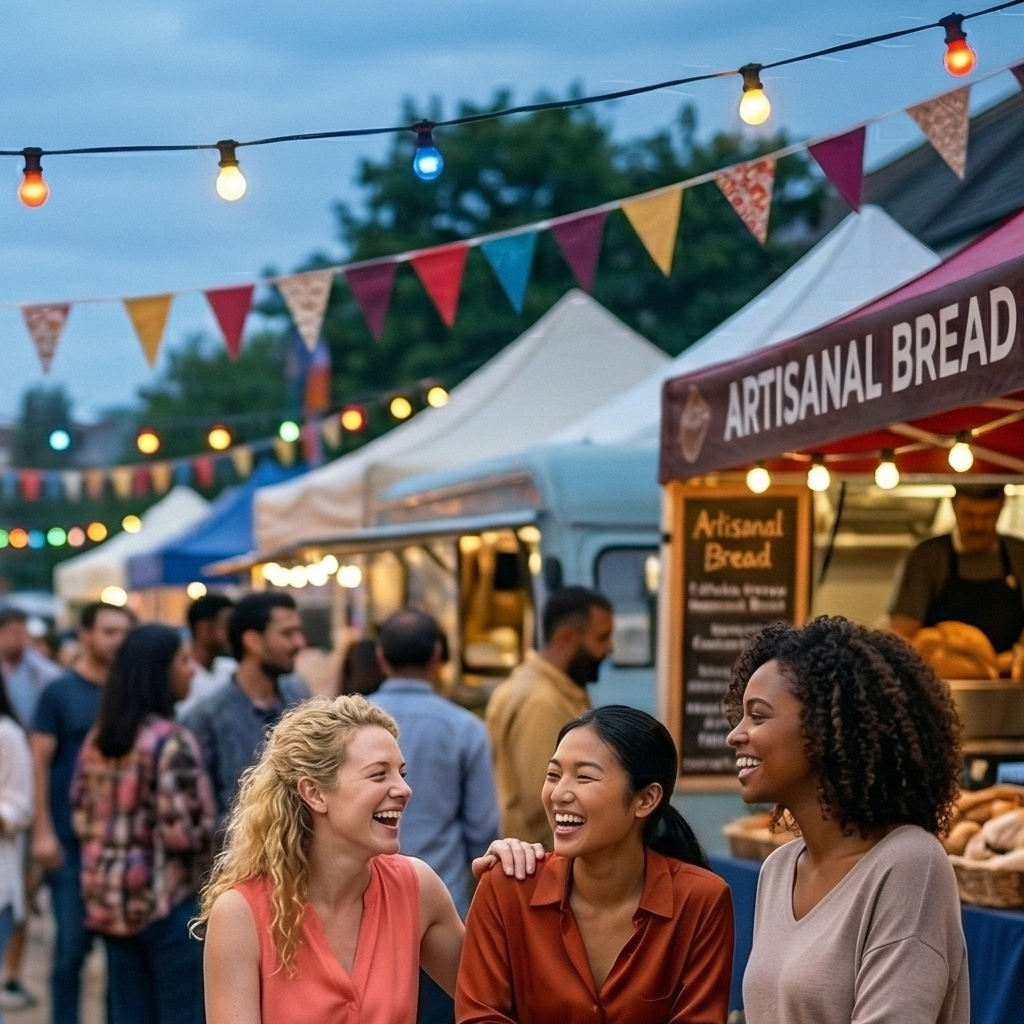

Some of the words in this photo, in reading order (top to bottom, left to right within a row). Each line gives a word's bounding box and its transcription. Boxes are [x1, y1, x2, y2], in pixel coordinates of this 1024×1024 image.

[724, 334, 882, 442] ARTISANAL
[892, 286, 1017, 393] BREAD
[692, 508, 784, 540] Artisanal
[704, 541, 773, 573] Bread
